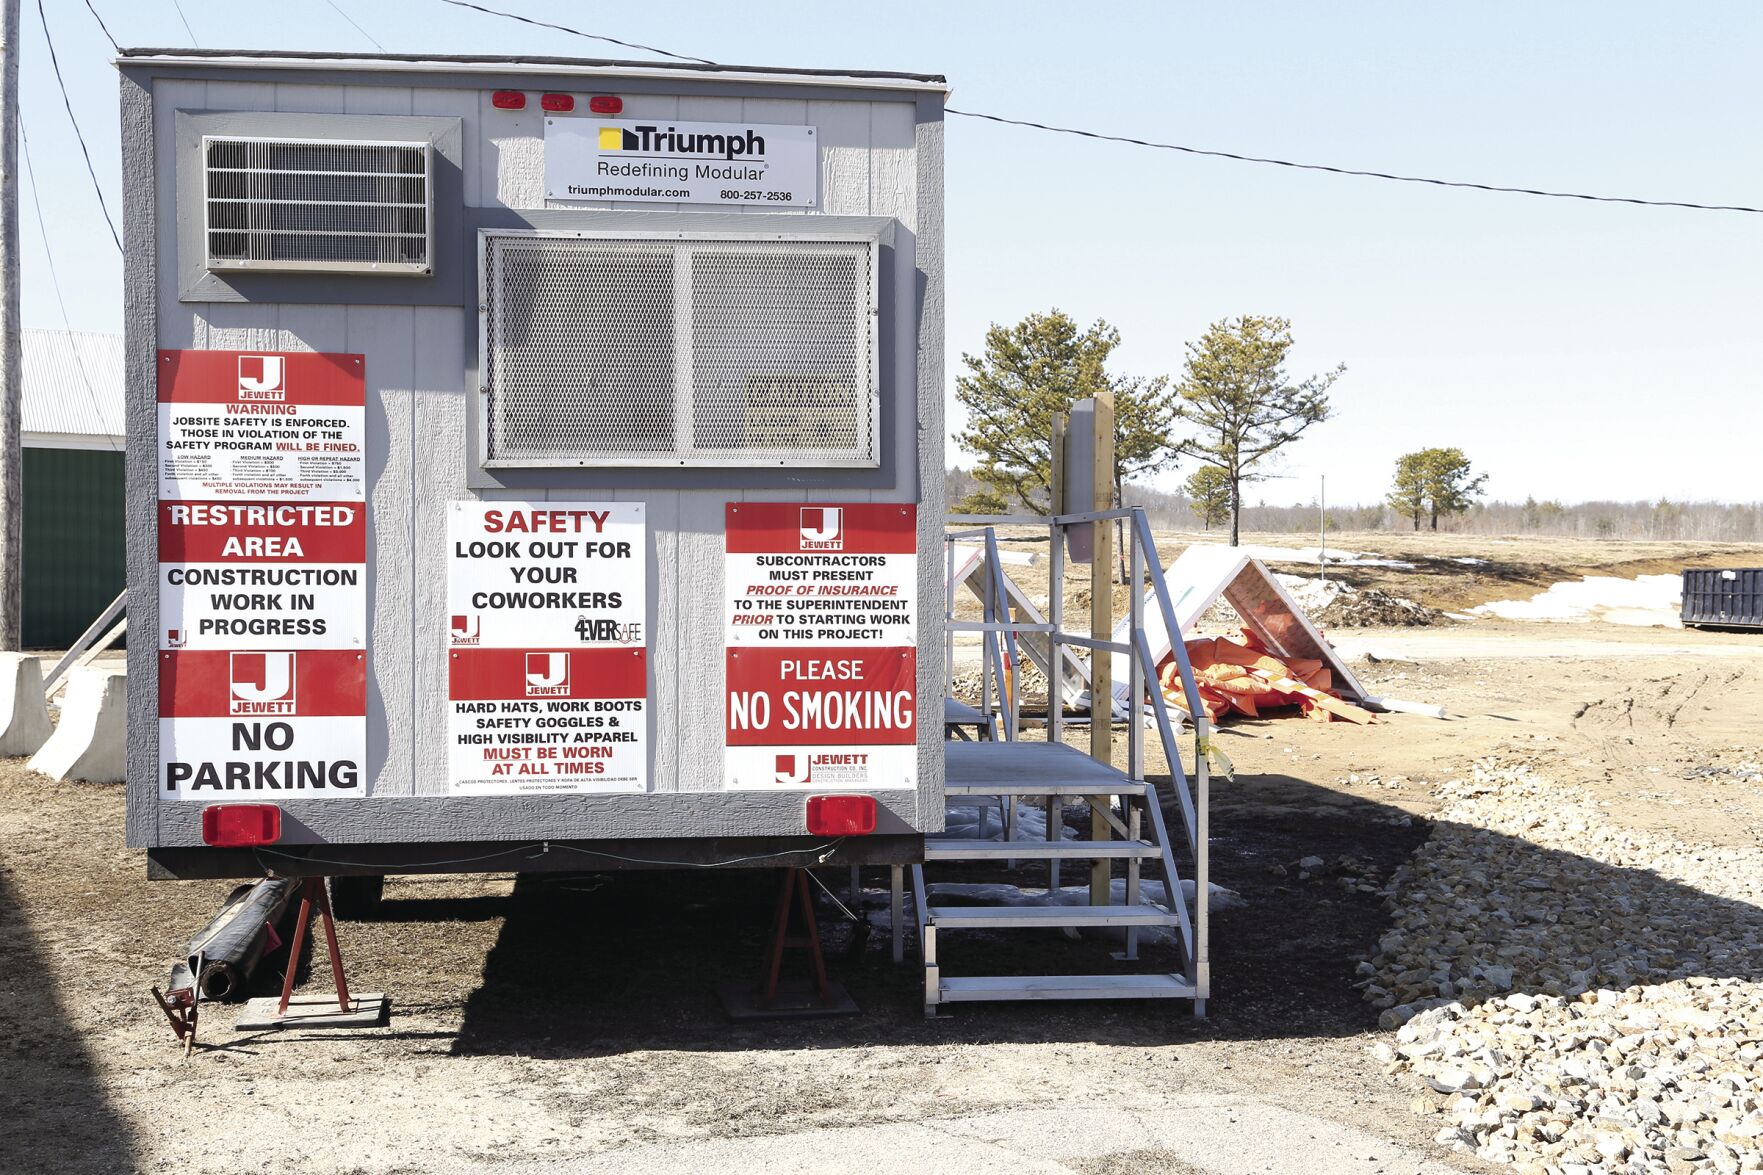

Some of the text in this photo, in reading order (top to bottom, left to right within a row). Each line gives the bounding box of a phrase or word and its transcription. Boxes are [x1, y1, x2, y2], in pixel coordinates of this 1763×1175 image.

[635, 126, 764, 159] Triumph
[598, 163, 688, 181] Redefining
[568, 186, 690, 198] triumphmodular.com
[720, 190, 792, 201] 800-257-2536
[226, 405, 296, 415] WARNING
[224, 418, 266, 426] SAFETY
[285, 419, 350, 428] ENFORCED.
[180, 430, 219, 438] THOSE
[238, 430, 299, 439] VIOLATION
[302, 431, 318, 439] OF
[321, 431, 342, 440] THE
[166, 441, 360, 452] SAFETY PROGRAM WILL BE FINED.
[171, 506, 354, 526] RESTRICTED
[484, 510, 610, 533] SAFETY
[222, 537, 304, 556] AREA
[456, 542, 630, 558] LOOK OUT FOR
[756, 556, 886, 566] SUBCONTRACTORS
[168, 569, 357, 585] CONSTRUCTION
[510, 567, 577, 583] YOUR
[769, 571, 873, 580] MUST PRESENT
[746, 586, 898, 595] PROOF OF INSURANCE
[211, 594, 314, 610] WORK IN
[472, 592, 622, 609] COWORKERS
[734, 600, 908, 610] TO THE SUPERINTENDENT
[732, 615, 910, 625] PRIOR TO STARTING WORK
[200, 619, 326, 635] PROGRESS
[759, 630, 883, 639] ON THIS PROJECT!
[780, 660, 863, 680] PLEASE
[233, 702, 293, 713] JEWETT
[456, 701, 641, 713] HARD HATS, WORK BOOTS
[731, 691, 912, 729] NO SMOKING
[476, 717, 619, 728] SAFETY GOGGLES &
[232, 722, 294, 751] NO
[458, 732, 637, 744] HIGH VISIBILITY APPAREL
[483, 747, 612, 760] MUST BE WORN
[813, 755, 868, 764] JEWETT
[492, 762, 604, 775] AT ALL TIMES
[167, 760, 358, 790] PARKING
